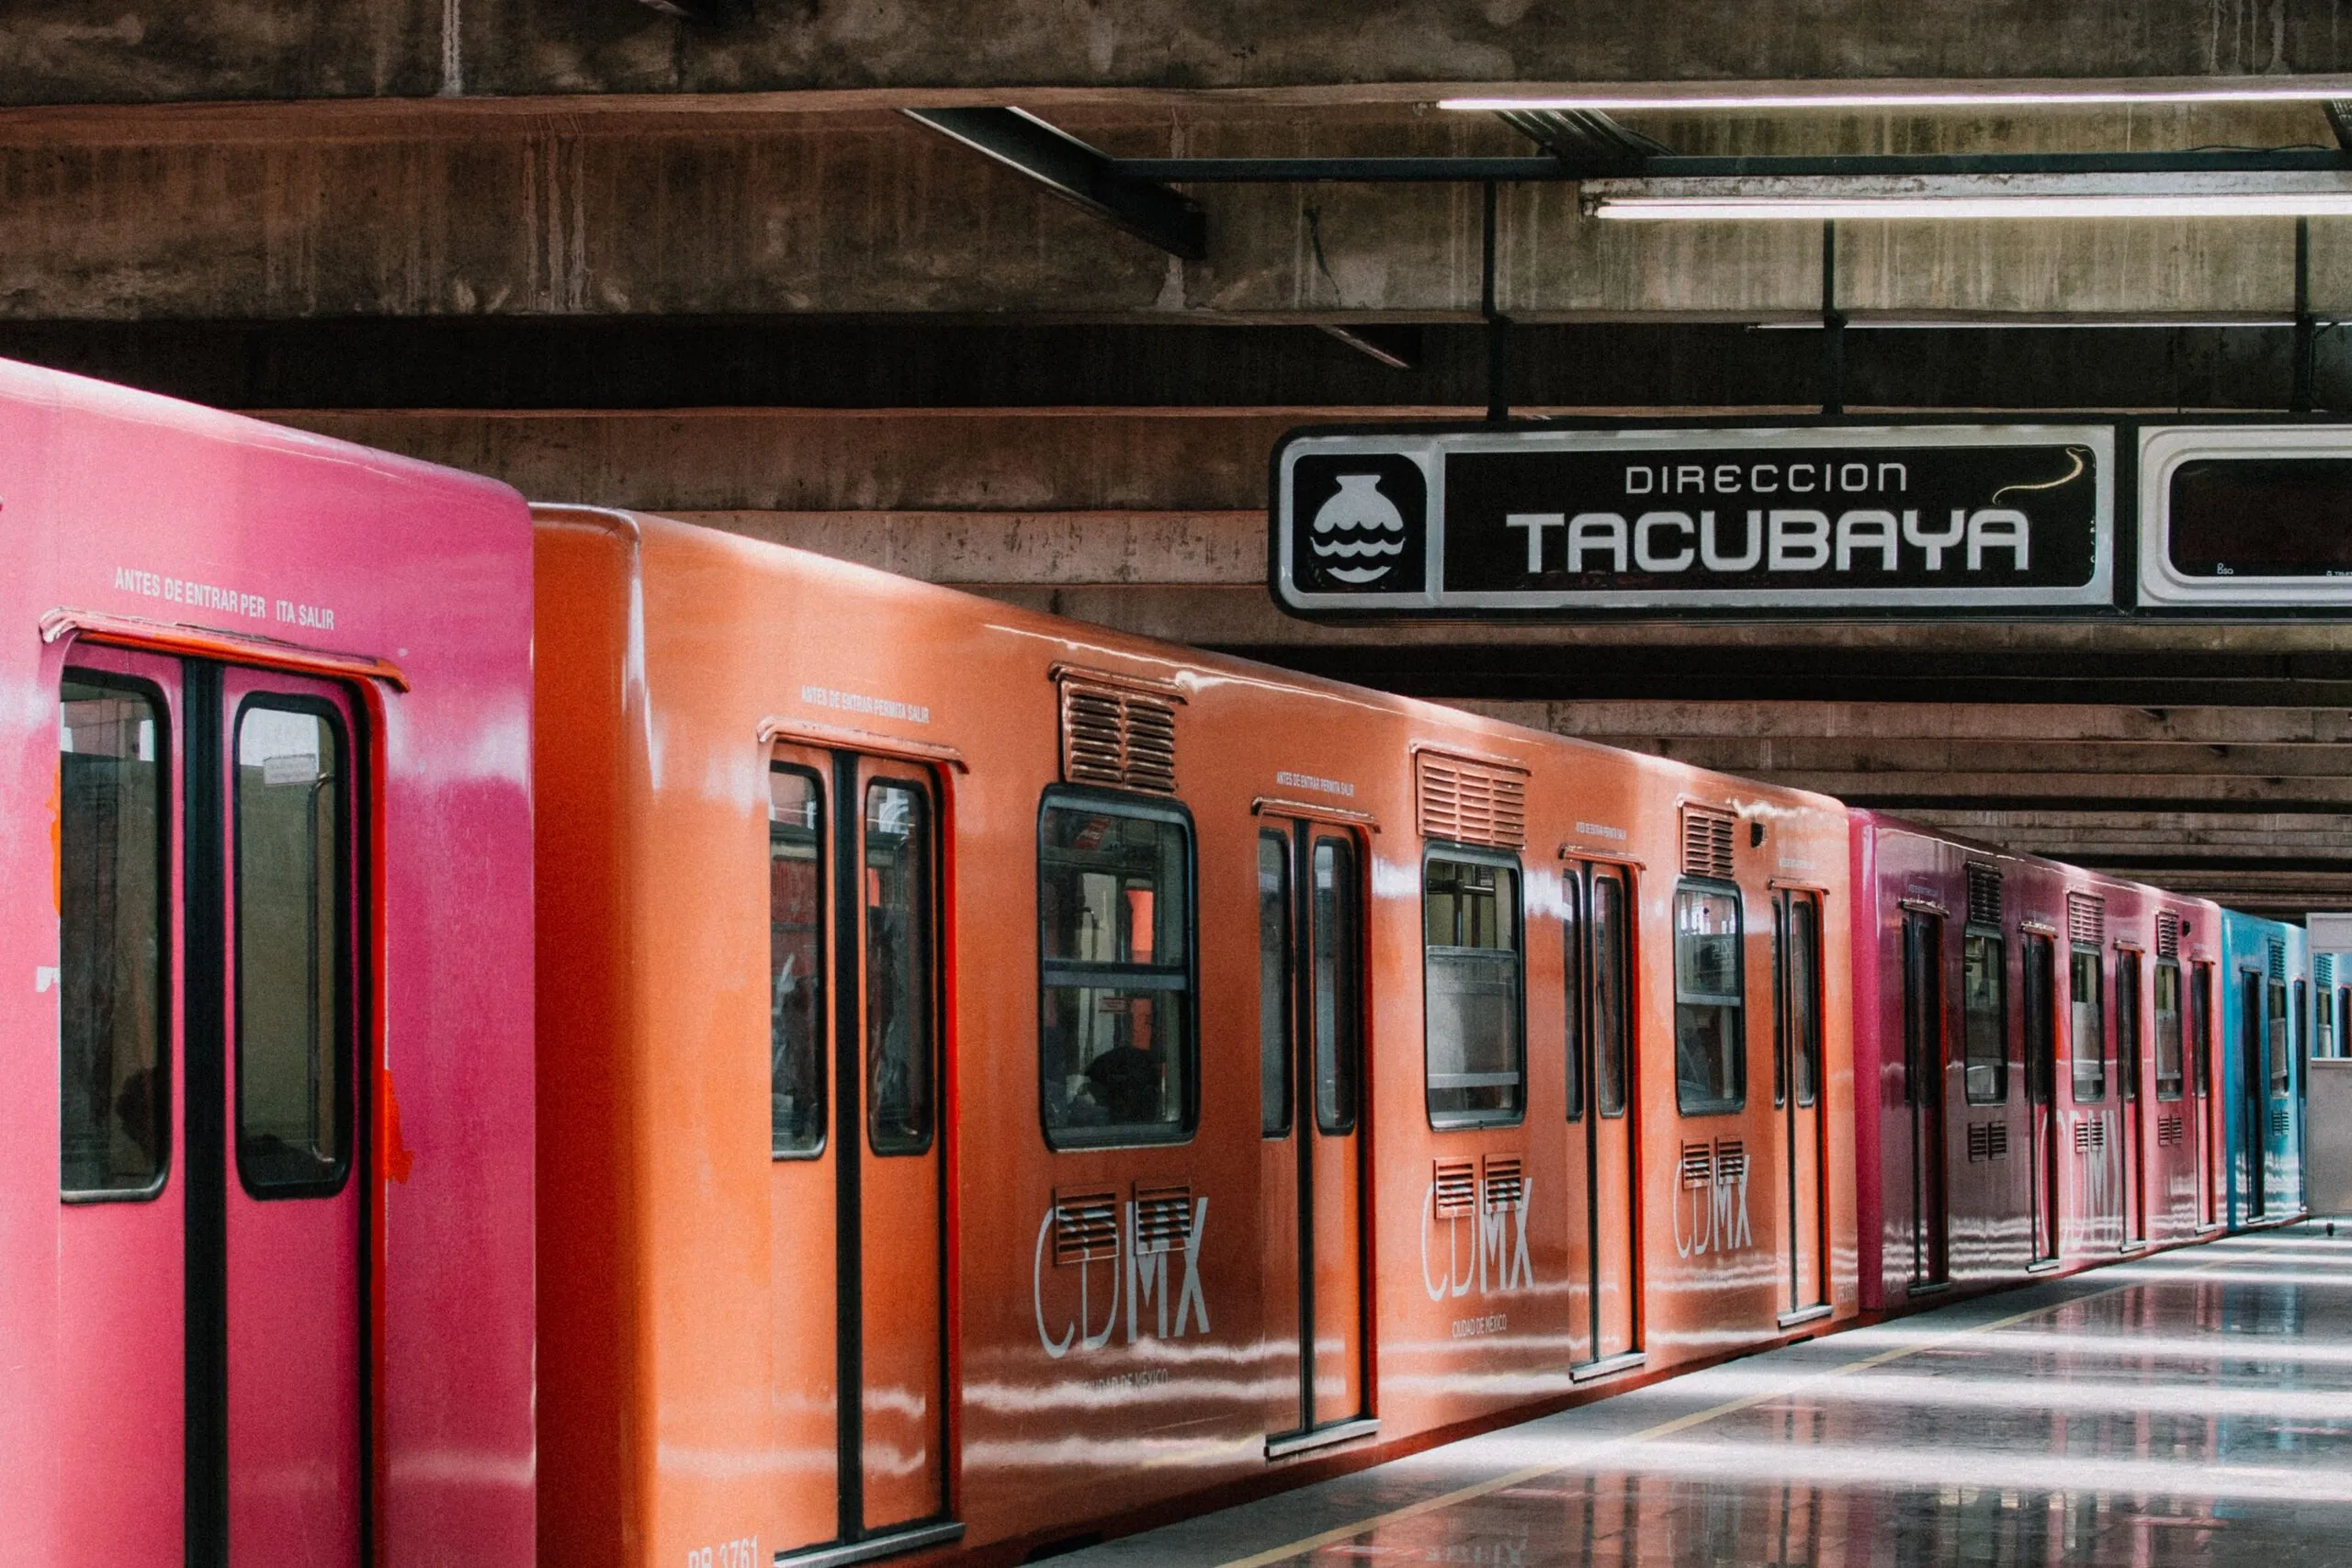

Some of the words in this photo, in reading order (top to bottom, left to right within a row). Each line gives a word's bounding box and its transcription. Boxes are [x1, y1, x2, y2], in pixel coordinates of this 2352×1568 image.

[1625, 463, 1907, 494] DIRECCION
[1506, 509, 2030, 573] TACUBAYA
[114, 566, 160, 596] ANTES
[164, 576, 183, 603] DE
[186, 582, 238, 613] ENTRAR
[299, 604, 334, 631] SALIR
[801, 684, 827, 706] ANTES
[829, 690, 841, 708] DE
[842, 692, 873, 714] ENTRAR
[874, 697, 907, 720] PERMITA
[908, 704, 930, 725] SALIR
[1673, 1154, 1752, 1259] CDMX
[1421, 1177, 1533, 1303] CDMX
[1035, 1197, 1210, 1359] CDMX
[1476, 1316, 1485, 1335] DE
